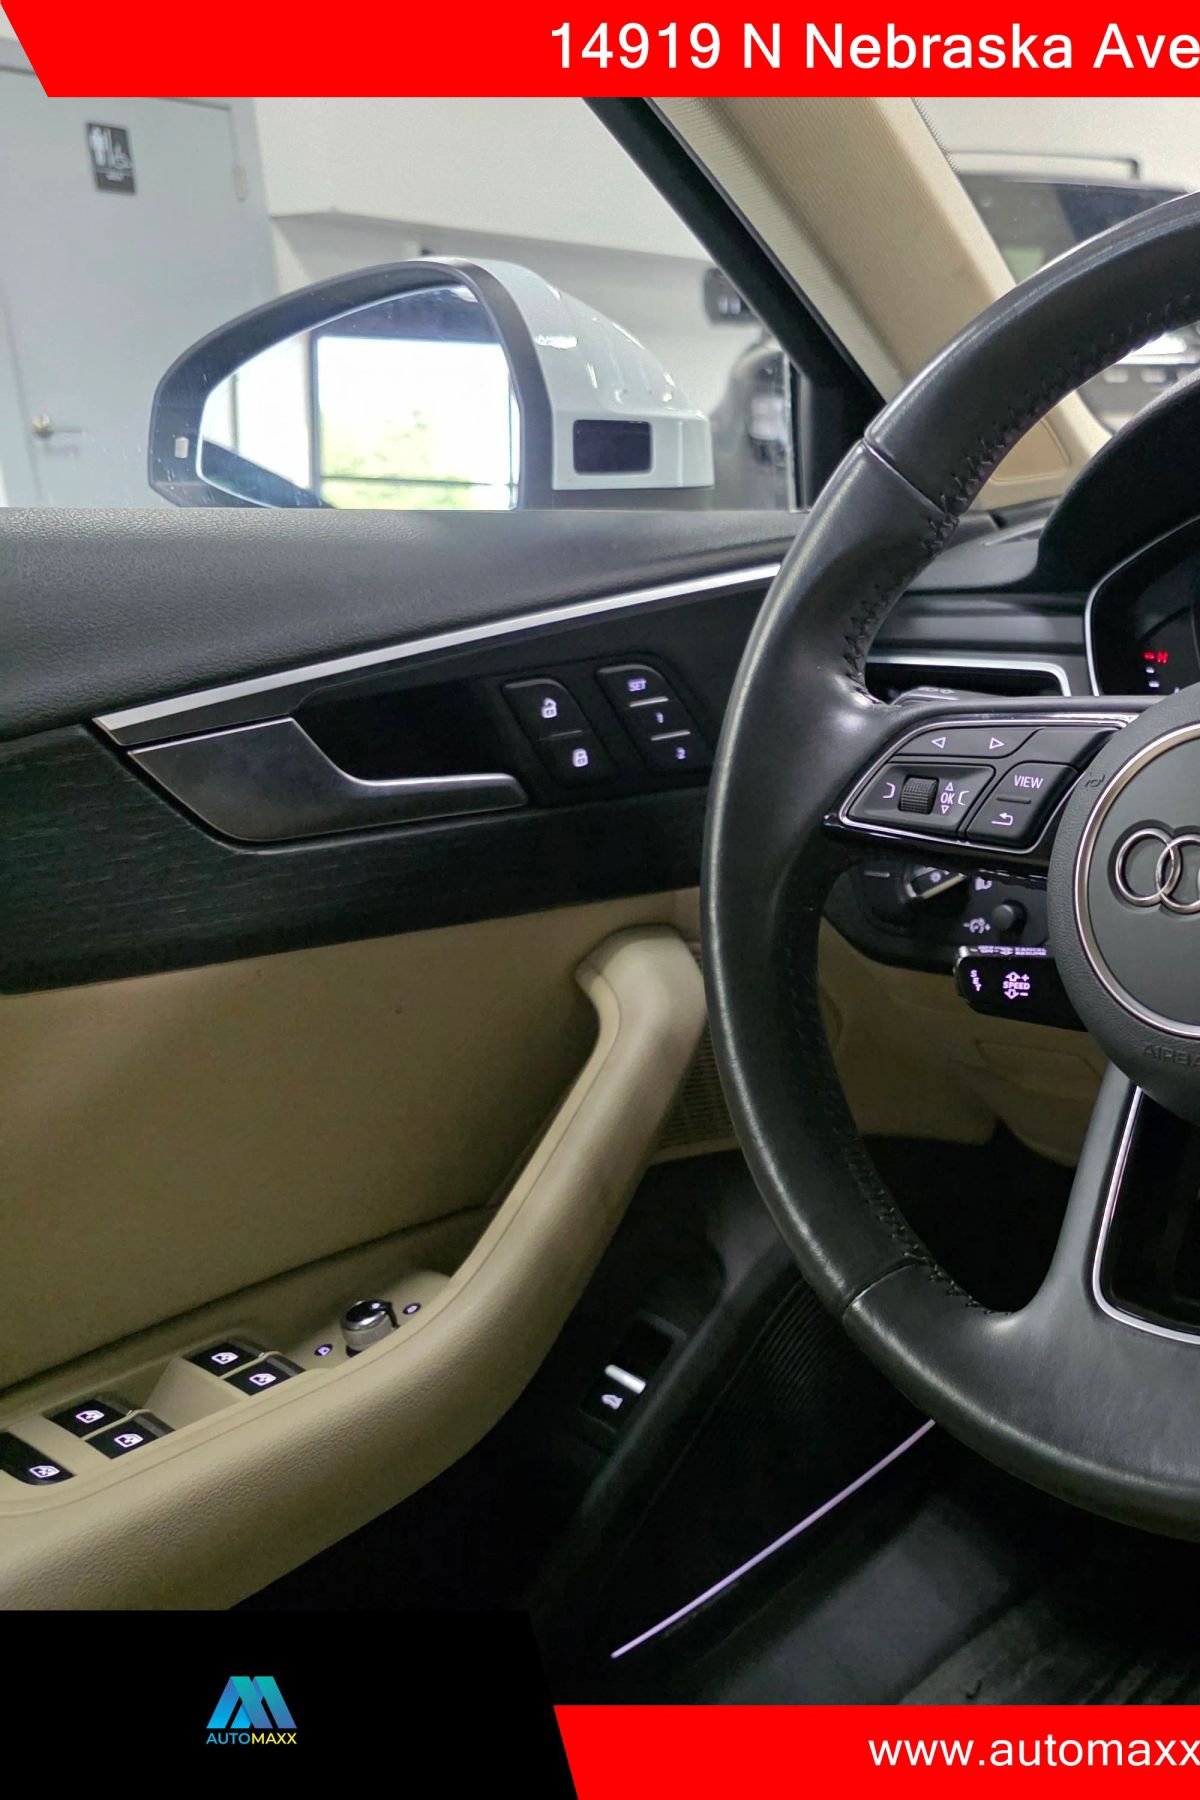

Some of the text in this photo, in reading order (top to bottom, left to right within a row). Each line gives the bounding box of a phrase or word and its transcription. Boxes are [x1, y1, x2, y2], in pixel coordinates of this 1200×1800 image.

[628, 678, 647, 692] SET
[1014, 775, 1043, 790] VIEW
[940, 792, 954, 805] OK
[970, 969, 982, 992] SET
[1002, 980, 1031, 990] SPEED
